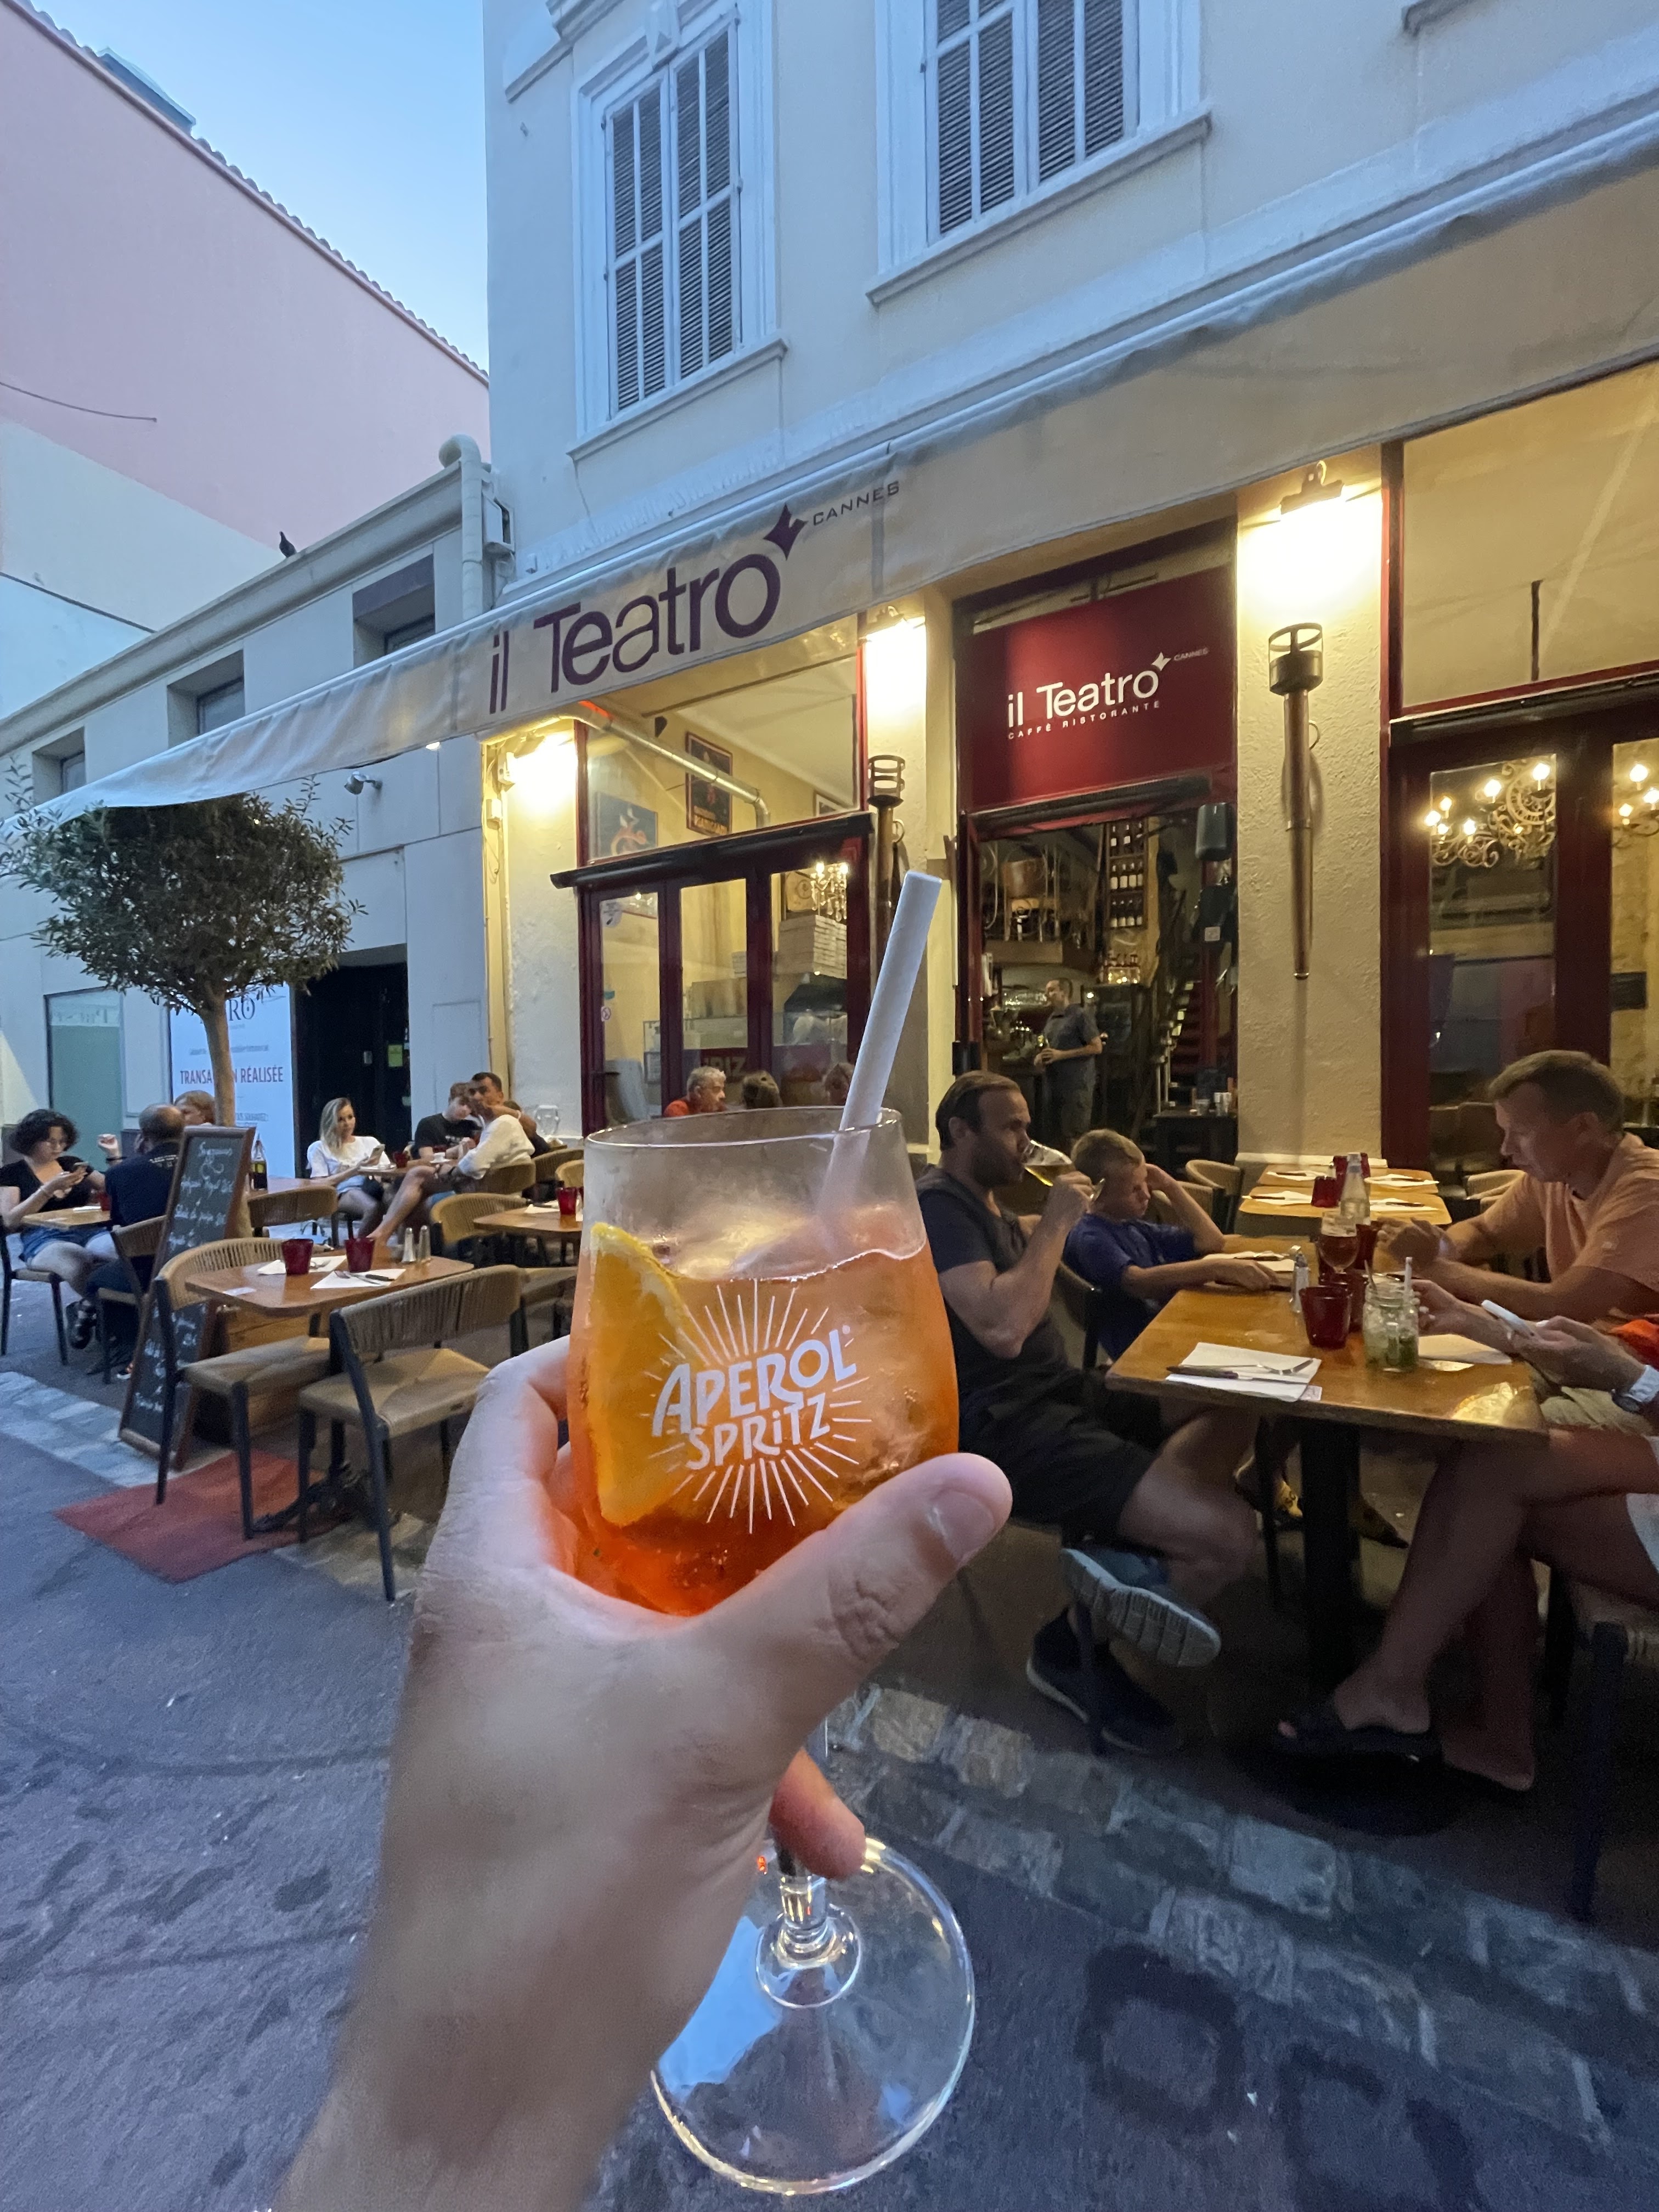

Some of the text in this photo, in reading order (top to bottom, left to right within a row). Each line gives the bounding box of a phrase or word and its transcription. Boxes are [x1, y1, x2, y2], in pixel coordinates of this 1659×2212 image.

[812, 481, 900, 527] CANNES
[489, 553, 781, 714] il Teatro
[1008, 670, 1159, 727] il Teatro
[1063, 701, 1160, 729] RISTORANTE
[240, 1065, 284, 1083] RÉALISÉE
[651, 1329, 857, 1437] APEROL
